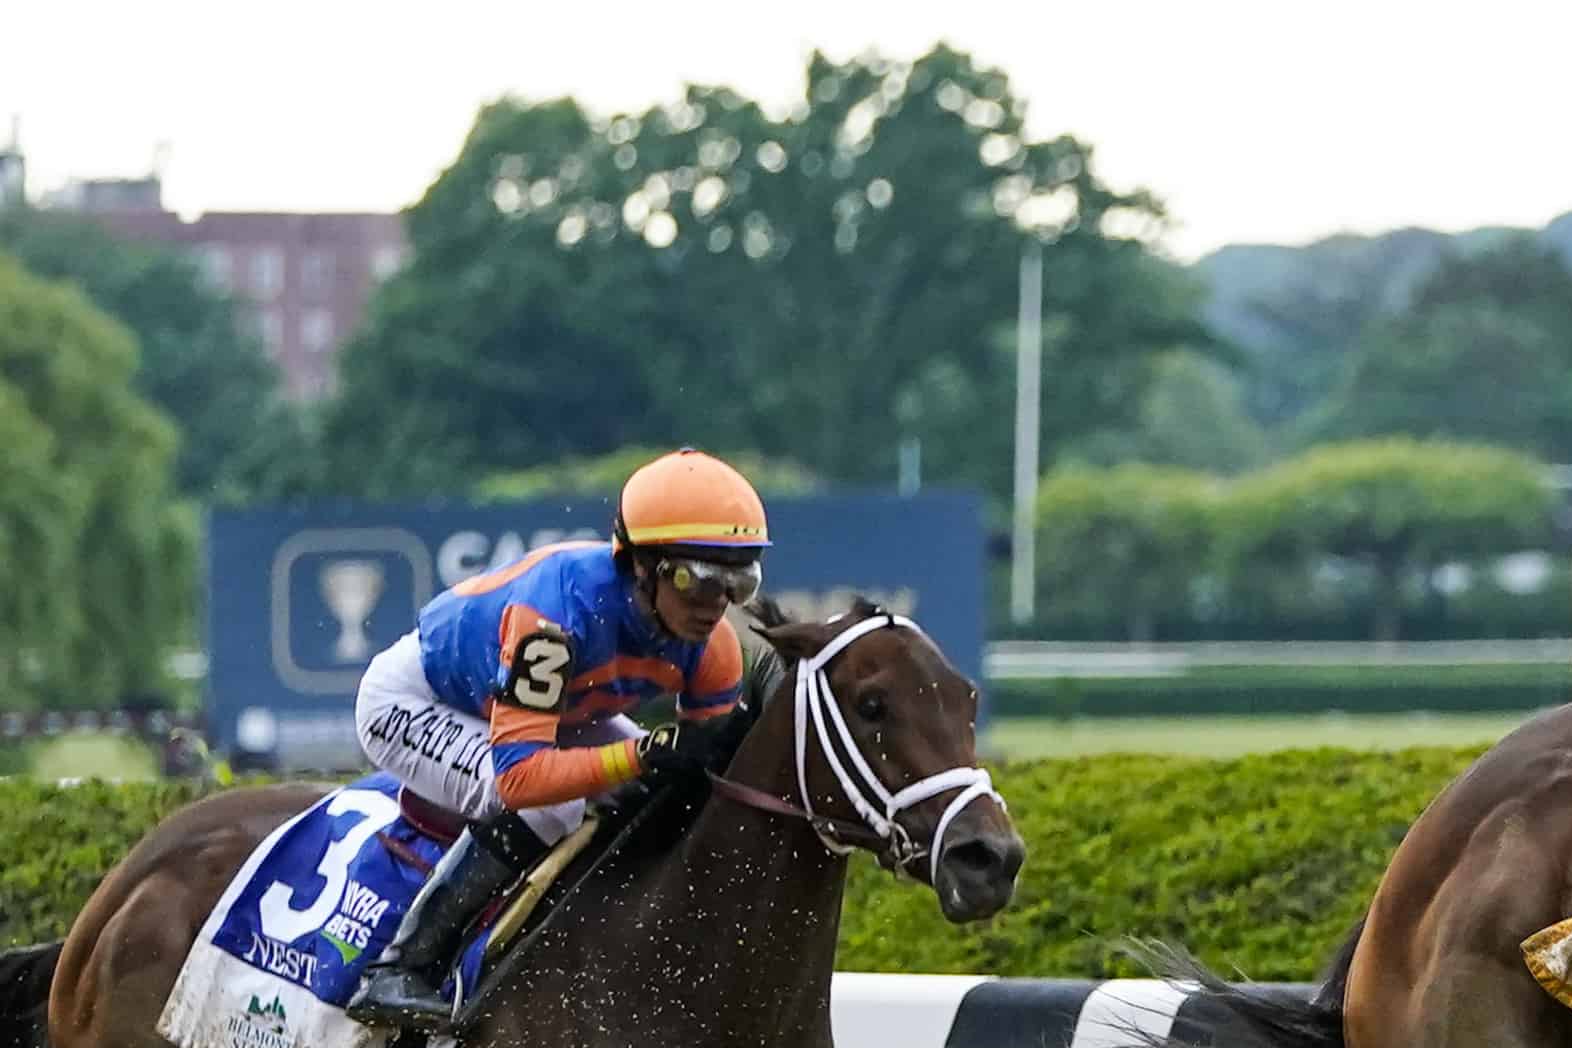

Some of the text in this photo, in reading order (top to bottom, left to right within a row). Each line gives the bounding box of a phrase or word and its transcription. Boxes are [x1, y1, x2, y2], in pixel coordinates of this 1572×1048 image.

[514, 639, 571, 709] 3
[259, 788, 401, 944] 3
[243, 931, 318, 987] NEST
[324, 914, 373, 949] BETS
